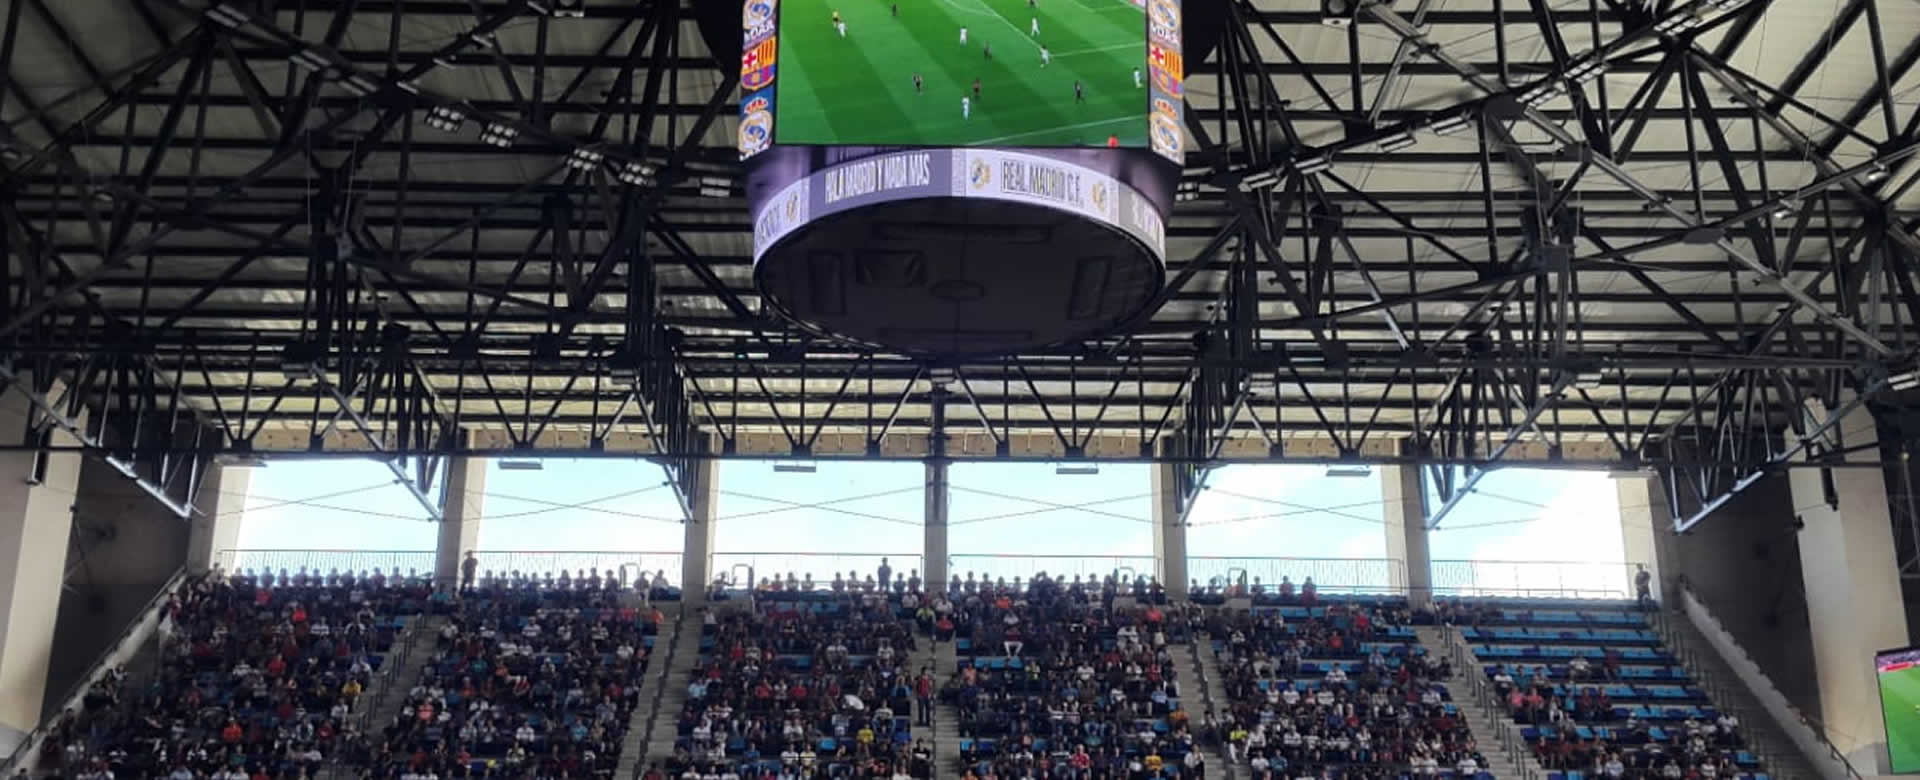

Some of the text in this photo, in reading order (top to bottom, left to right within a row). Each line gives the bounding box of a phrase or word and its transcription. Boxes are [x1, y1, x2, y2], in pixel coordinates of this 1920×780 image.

[845, 160, 876, 198] MADRID
[877, 159, 884, 191] Y
[909, 153, 930, 186] MAS
[1003, 161, 1028, 191] REAL
[1029, 165, 1065, 200] MADRID
